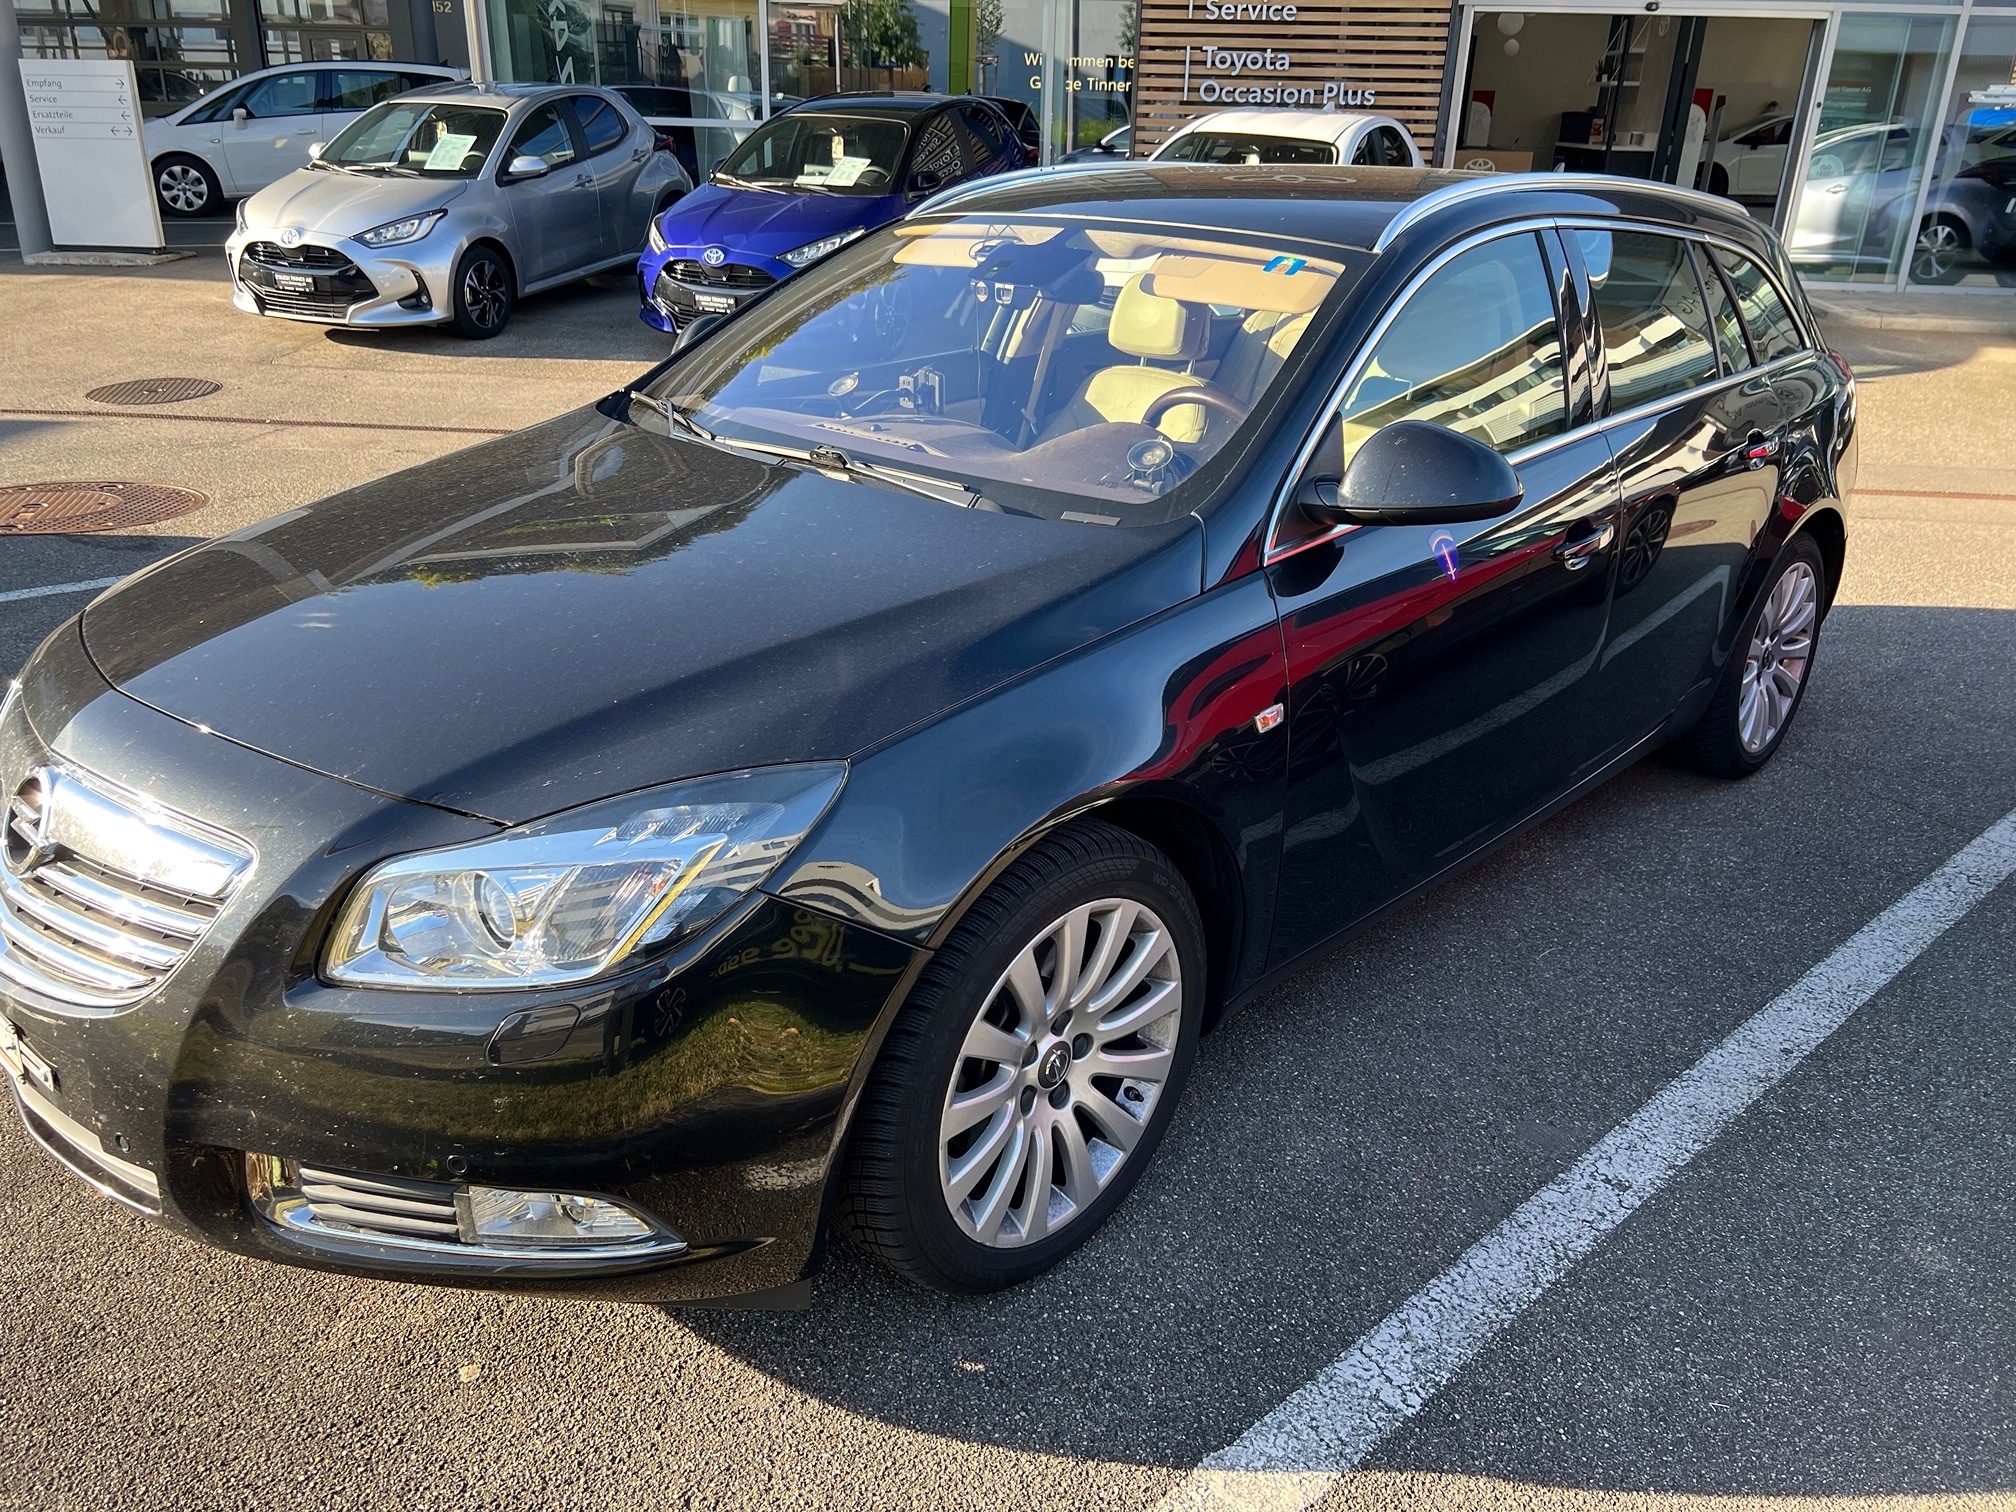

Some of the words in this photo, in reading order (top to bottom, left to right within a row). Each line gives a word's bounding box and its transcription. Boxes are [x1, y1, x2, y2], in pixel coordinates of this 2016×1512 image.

[1205, 0, 1298, 21] Service
[1202, 45, 1291, 76] Toyota
[26, 79, 63, 89] Empfang
[1086, 77, 1132, 92] Tinner
[1200, 79, 1315, 104] Occasion
[1322, 81, 1376, 105] Plus
[29, 94, 58, 103] Service
[32, 110, 74, 119] Ersatzteile
[34, 126, 65, 134] Verkauf
